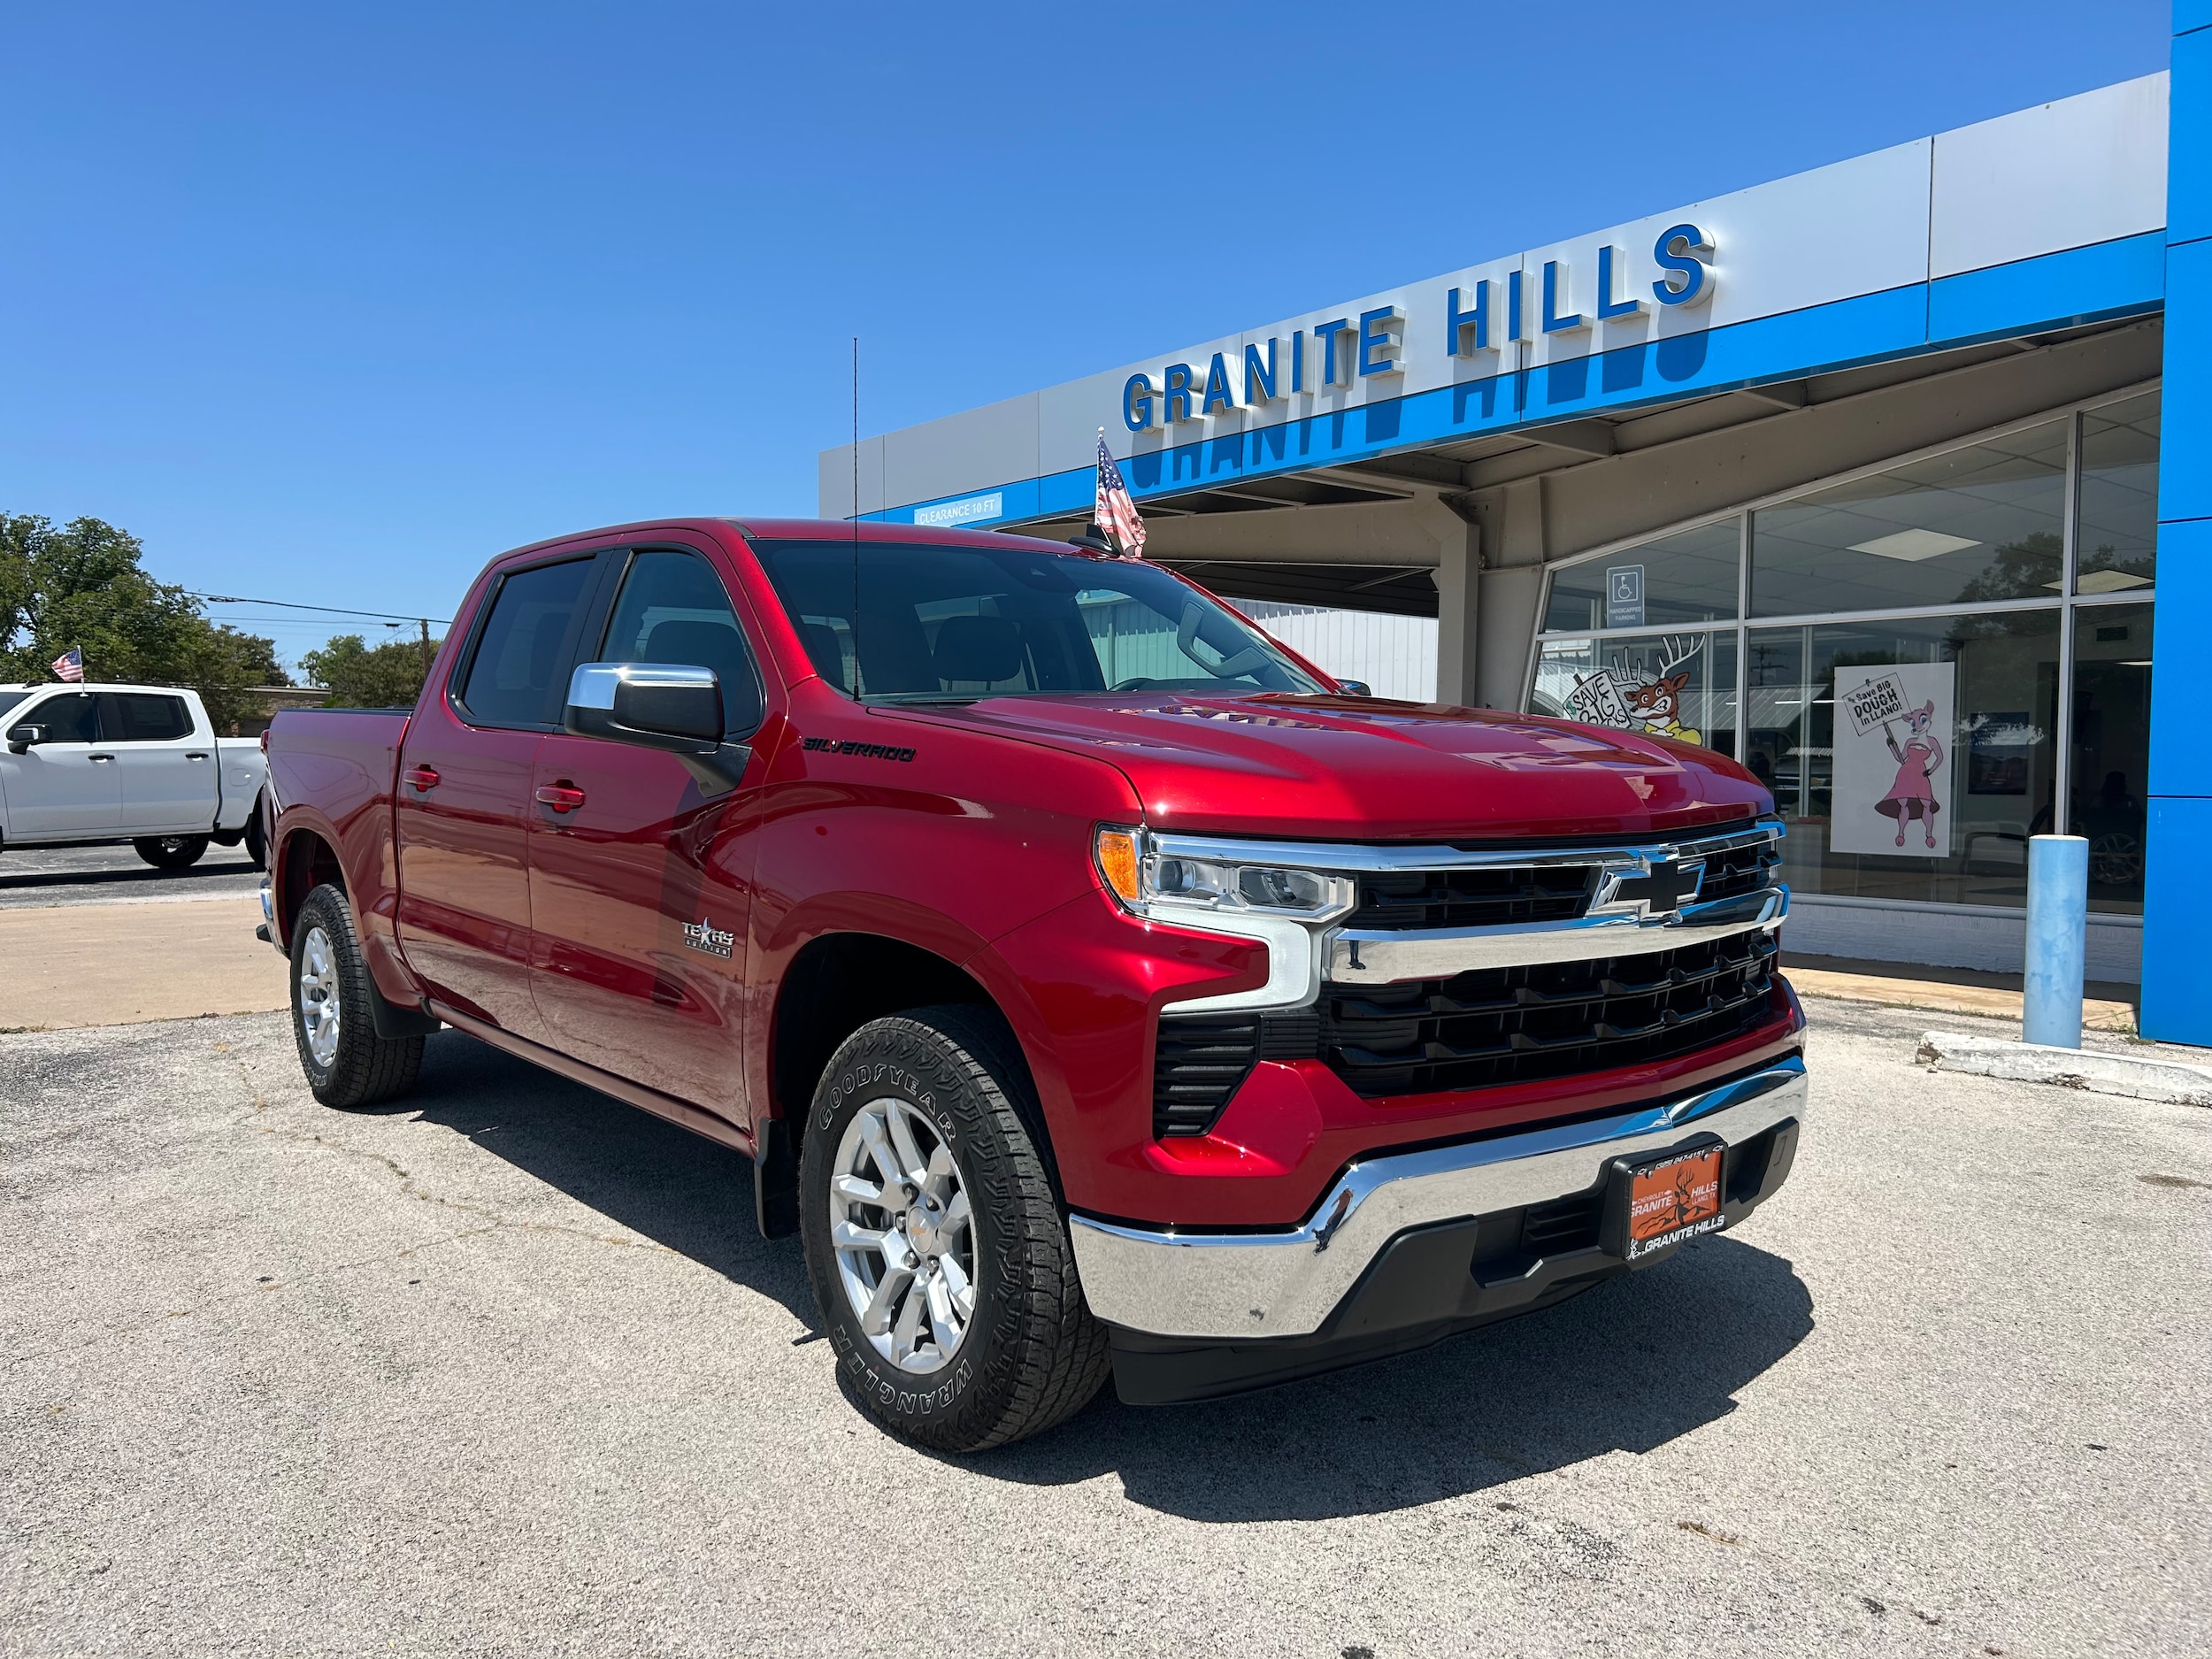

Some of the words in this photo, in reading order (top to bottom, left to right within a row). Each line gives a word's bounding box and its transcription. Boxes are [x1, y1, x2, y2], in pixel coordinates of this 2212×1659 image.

[1123, 305, 1405, 434] GRANITE
[1447, 223, 1716, 357] HILLS
[920, 504, 970, 525] CLEARANCE
[972, 502, 982, 514] 10
[984, 499, 995, 512] FT
[1572, 675, 1609, 710] SAVE
[1854, 688, 1899, 718] DOUGH
[1855, 688, 1876, 701] Save
[1876, 680, 1891, 693] BIG
[1870, 701, 1902, 721] LLANO!
[803, 737, 916, 762] SILVERADO
[681, 918, 734, 945] TEXAS
[686, 939, 727, 956] EDITION
[818, 1064, 956, 1142] GOODYEAR
[1637, 1191, 1664, 1204] CHEVROLET
[1691, 1180, 1718, 1198] HILLS
[1709, 1191, 1717, 1200] TX
[1644, 1225, 1694, 1252] GRANITE
[1694, 1214, 1725, 1235] HILLS
[833, 1324, 973, 1414] WRANGLER
